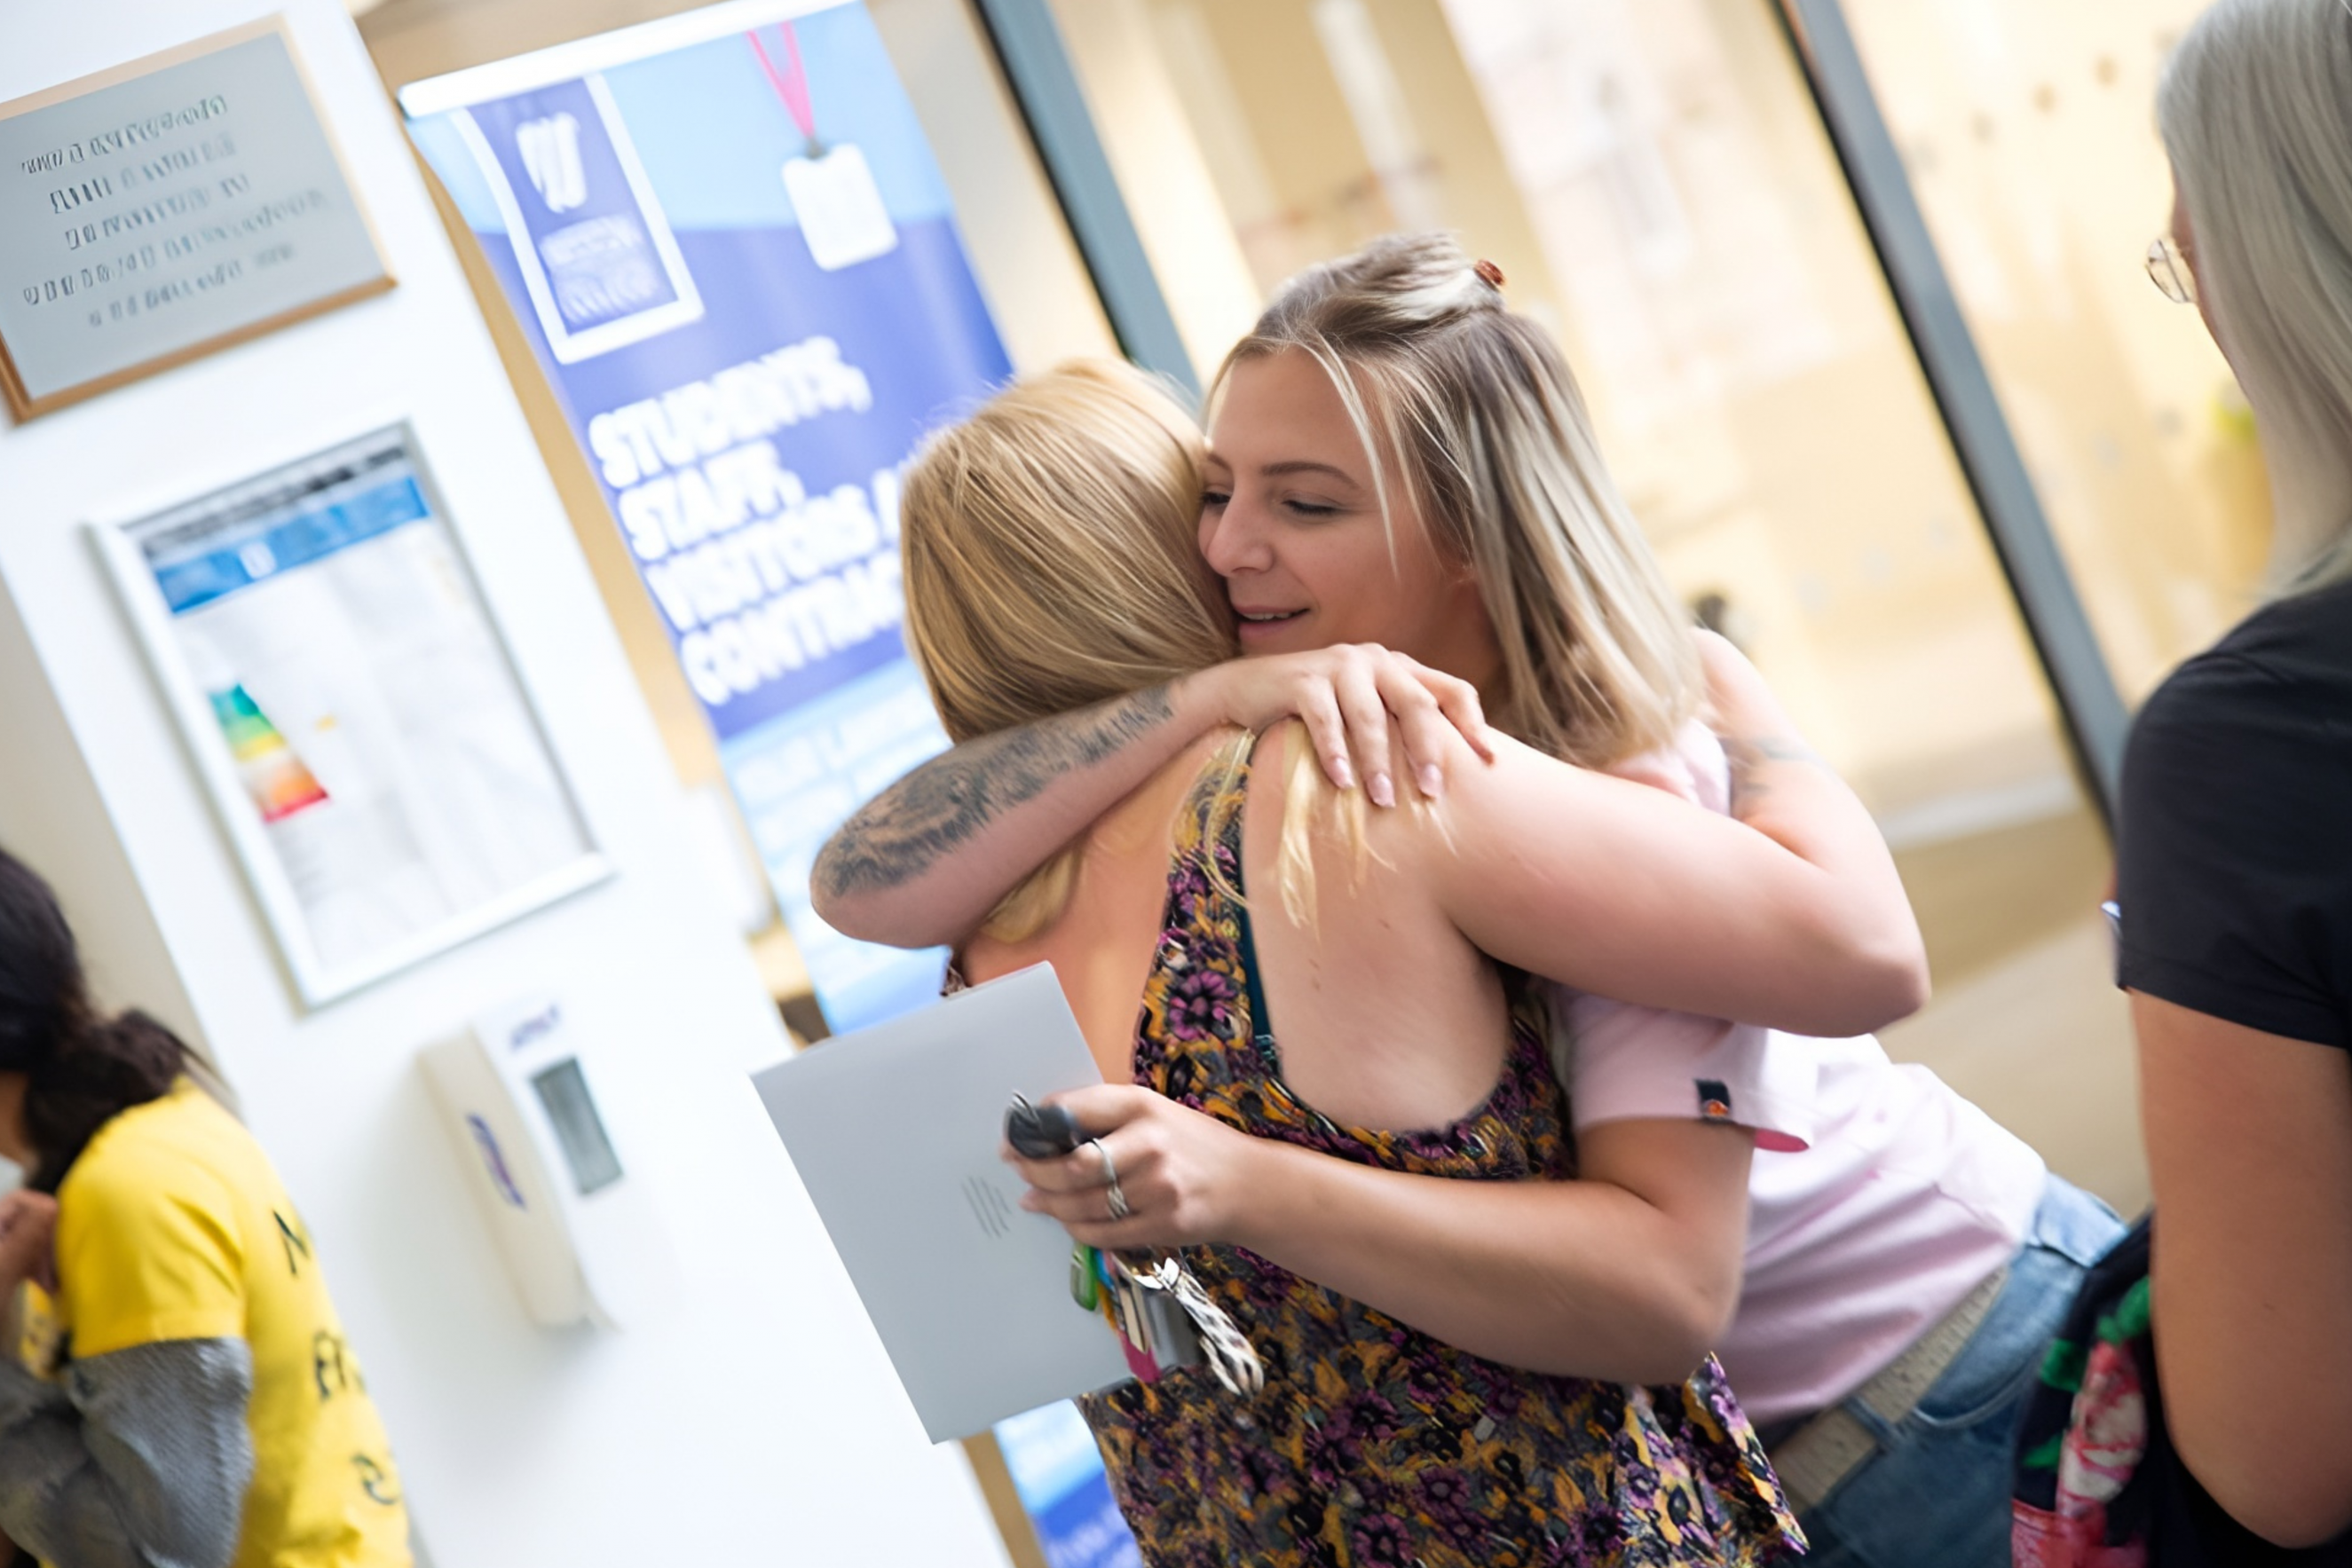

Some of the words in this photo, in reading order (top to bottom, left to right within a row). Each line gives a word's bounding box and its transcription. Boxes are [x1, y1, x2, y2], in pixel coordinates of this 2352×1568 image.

[588, 335, 873, 489] STUDENTS,
[619, 438, 805, 562] STAFF,
[645, 484, 880, 633] VISITORS
